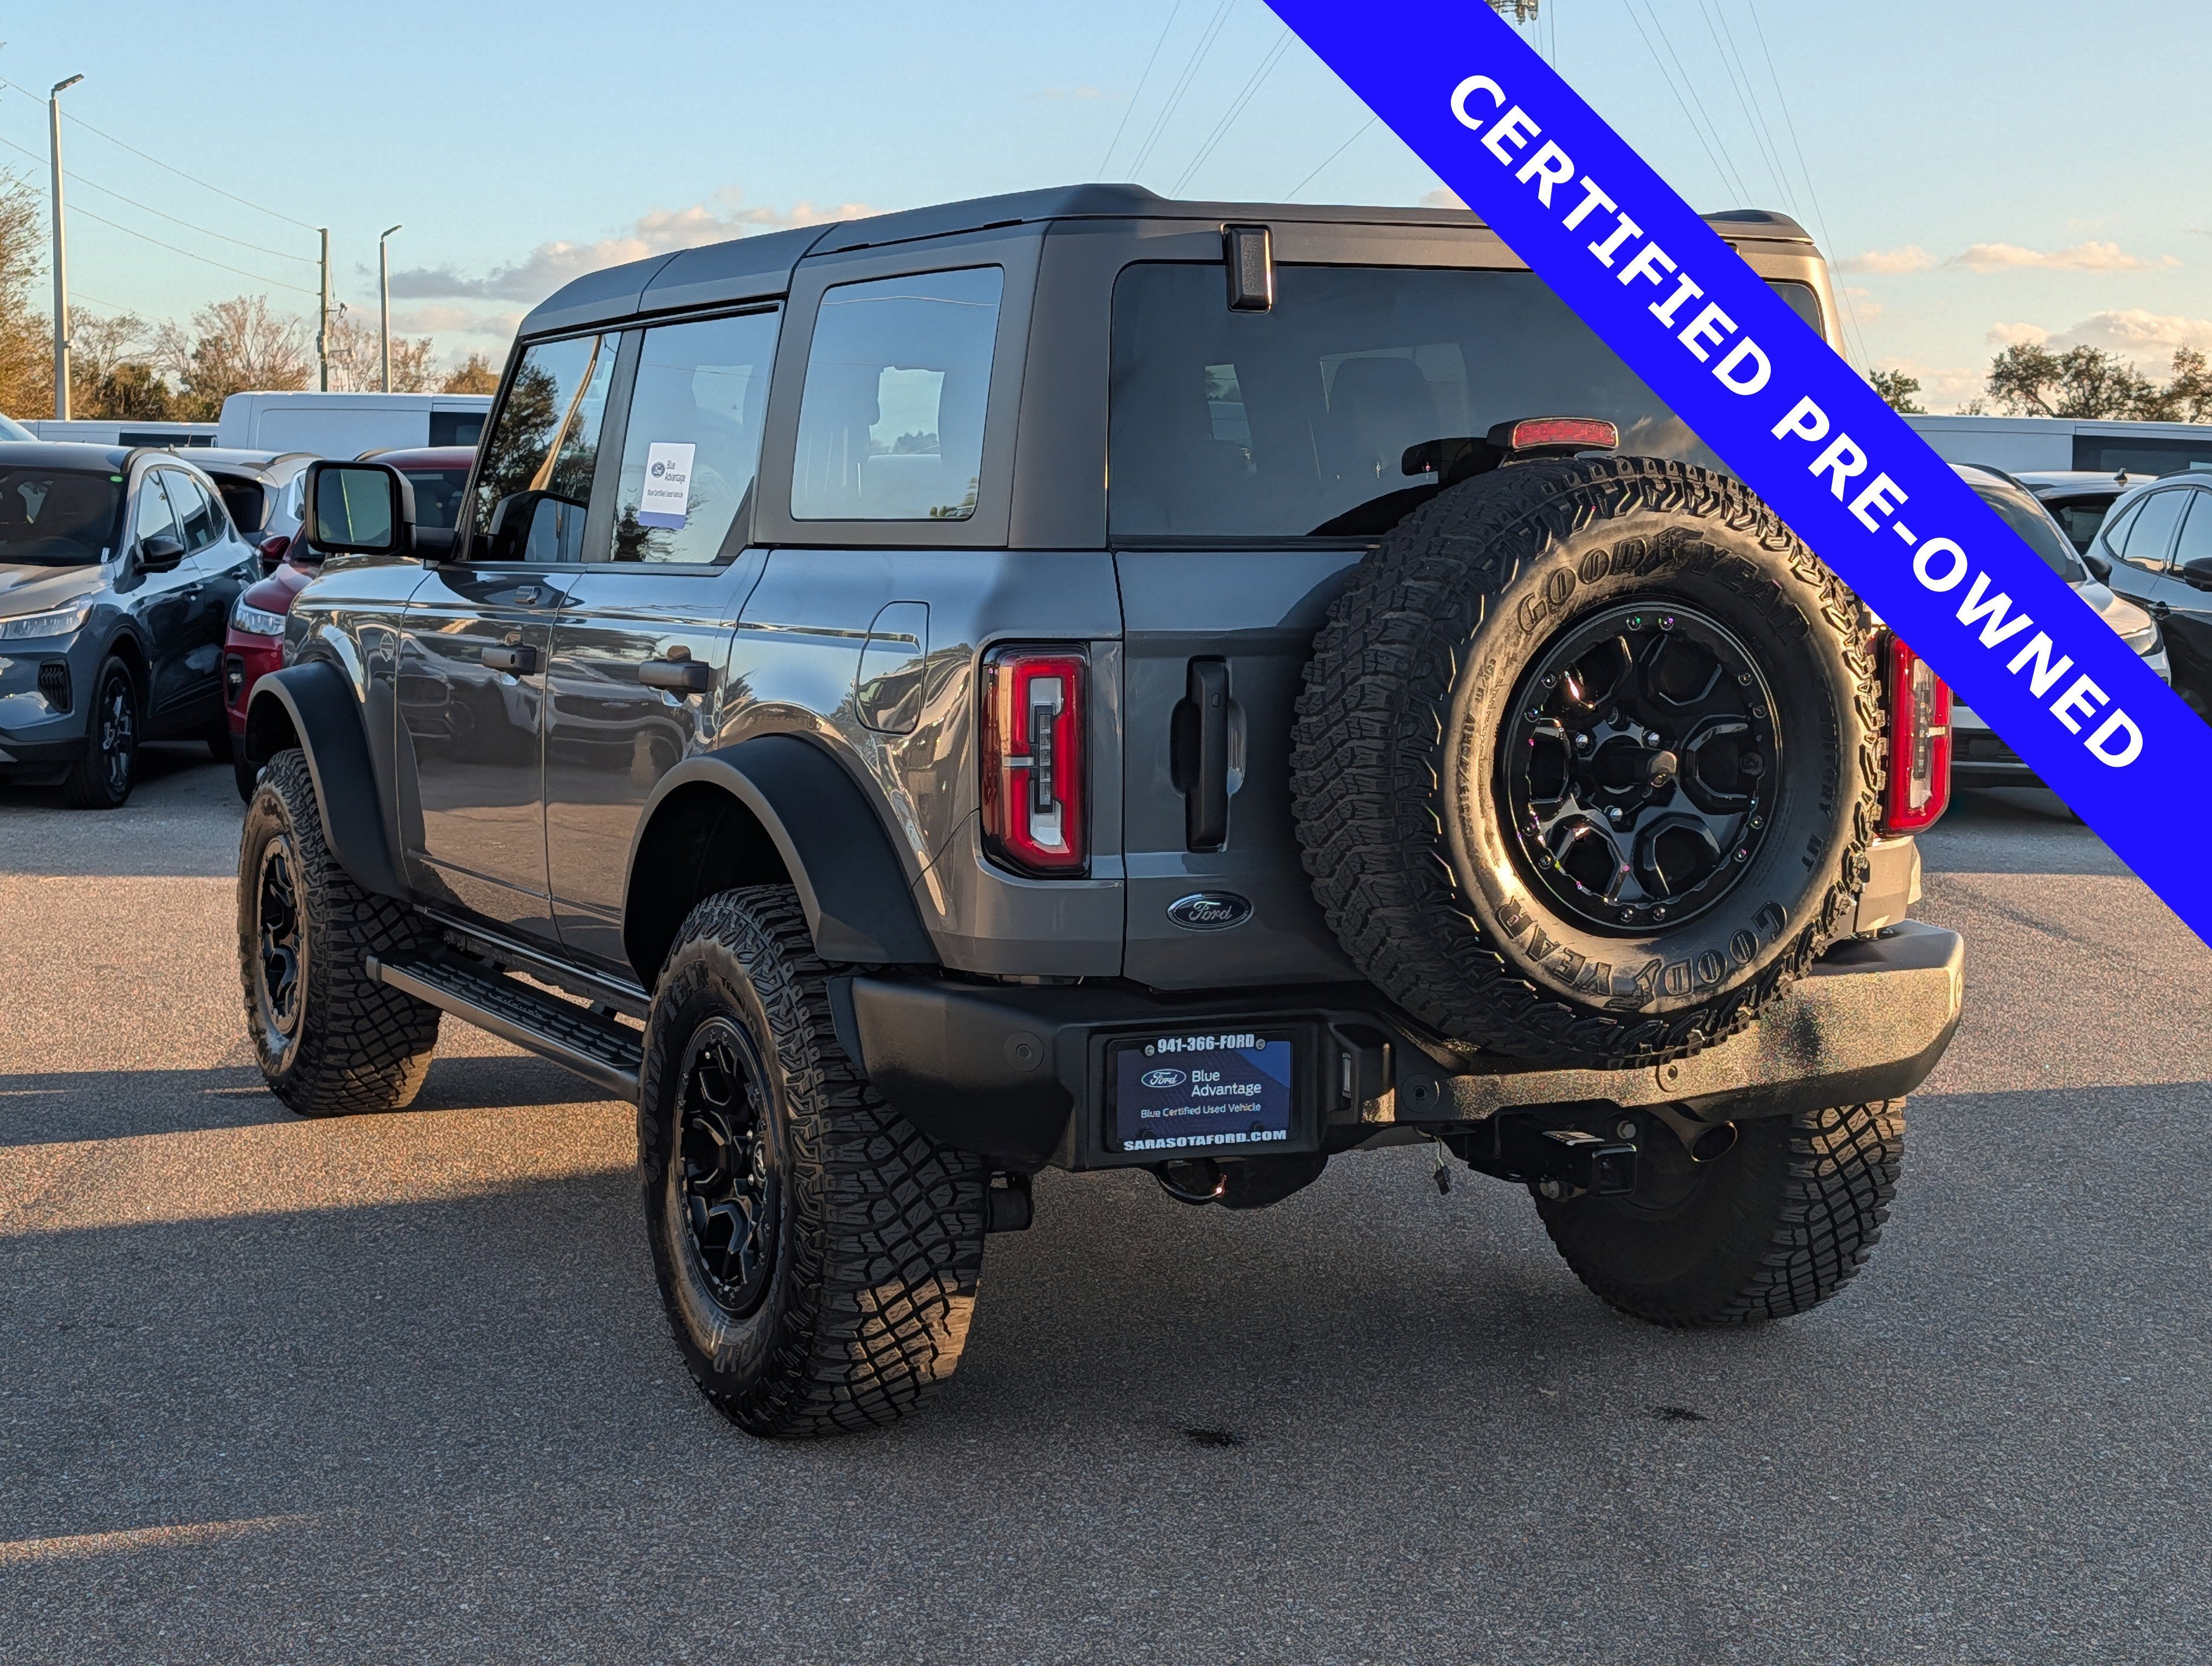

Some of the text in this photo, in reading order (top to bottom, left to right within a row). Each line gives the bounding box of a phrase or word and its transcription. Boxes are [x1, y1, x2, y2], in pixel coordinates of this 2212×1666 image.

[1189, 901, 1232, 921] Ford
[1158, 1034, 1255, 1054] 941-366-FORD
[1150, 1072, 1178, 1085] Ford
[1192, 1069, 1220, 1082] Blue
[1191, 1082, 1262, 1097] Advantage
[1163, 1106, 1201, 1117] Certified
[1203, 1104, 1226, 1114] Used
[1227, 1102, 1261, 1113] Vehicle
[1123, 1130, 1287, 1151] SARASOTAFORD.COM
